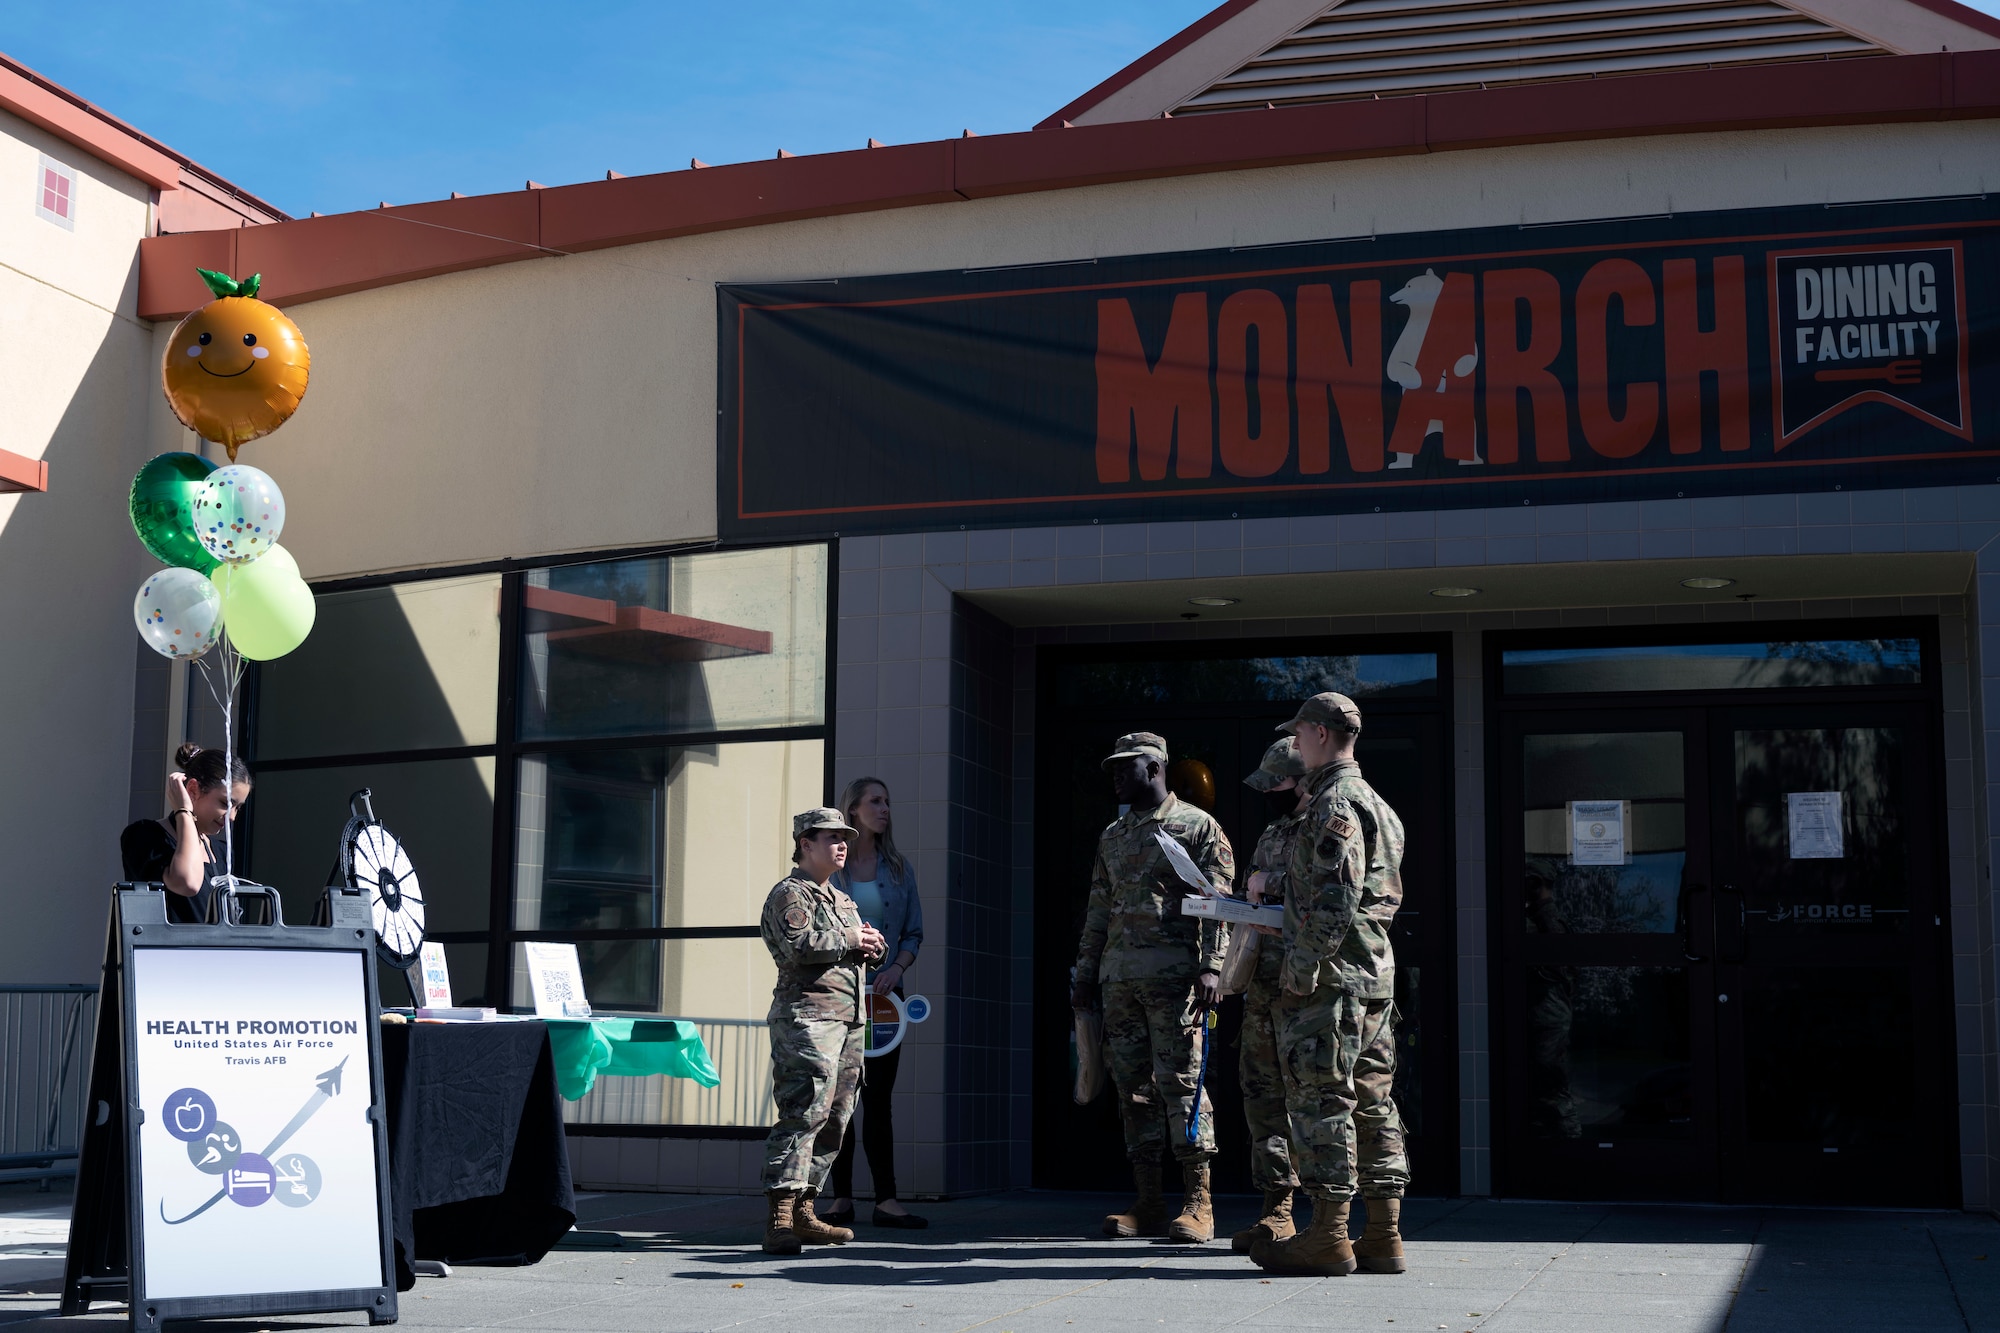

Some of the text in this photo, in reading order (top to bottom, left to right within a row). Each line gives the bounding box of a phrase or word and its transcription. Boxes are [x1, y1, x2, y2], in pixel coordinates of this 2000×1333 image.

[1796, 262, 1937, 321] DINING
[1796, 319, 1940, 363] FACILITY
[1095, 255, 1750, 484] MONARCH
[1331, 820, 1350, 834] MX
[1793, 904, 1873, 918] FORCE
[427, 969, 446, 983] WORLD
[429, 988, 447, 999] FLAVORS
[146, 1020, 358, 1035] HEALTH PROMOTION
[174, 1039, 333, 1049] United States Air Force
[225, 1056, 287, 1065] Travis AFB
